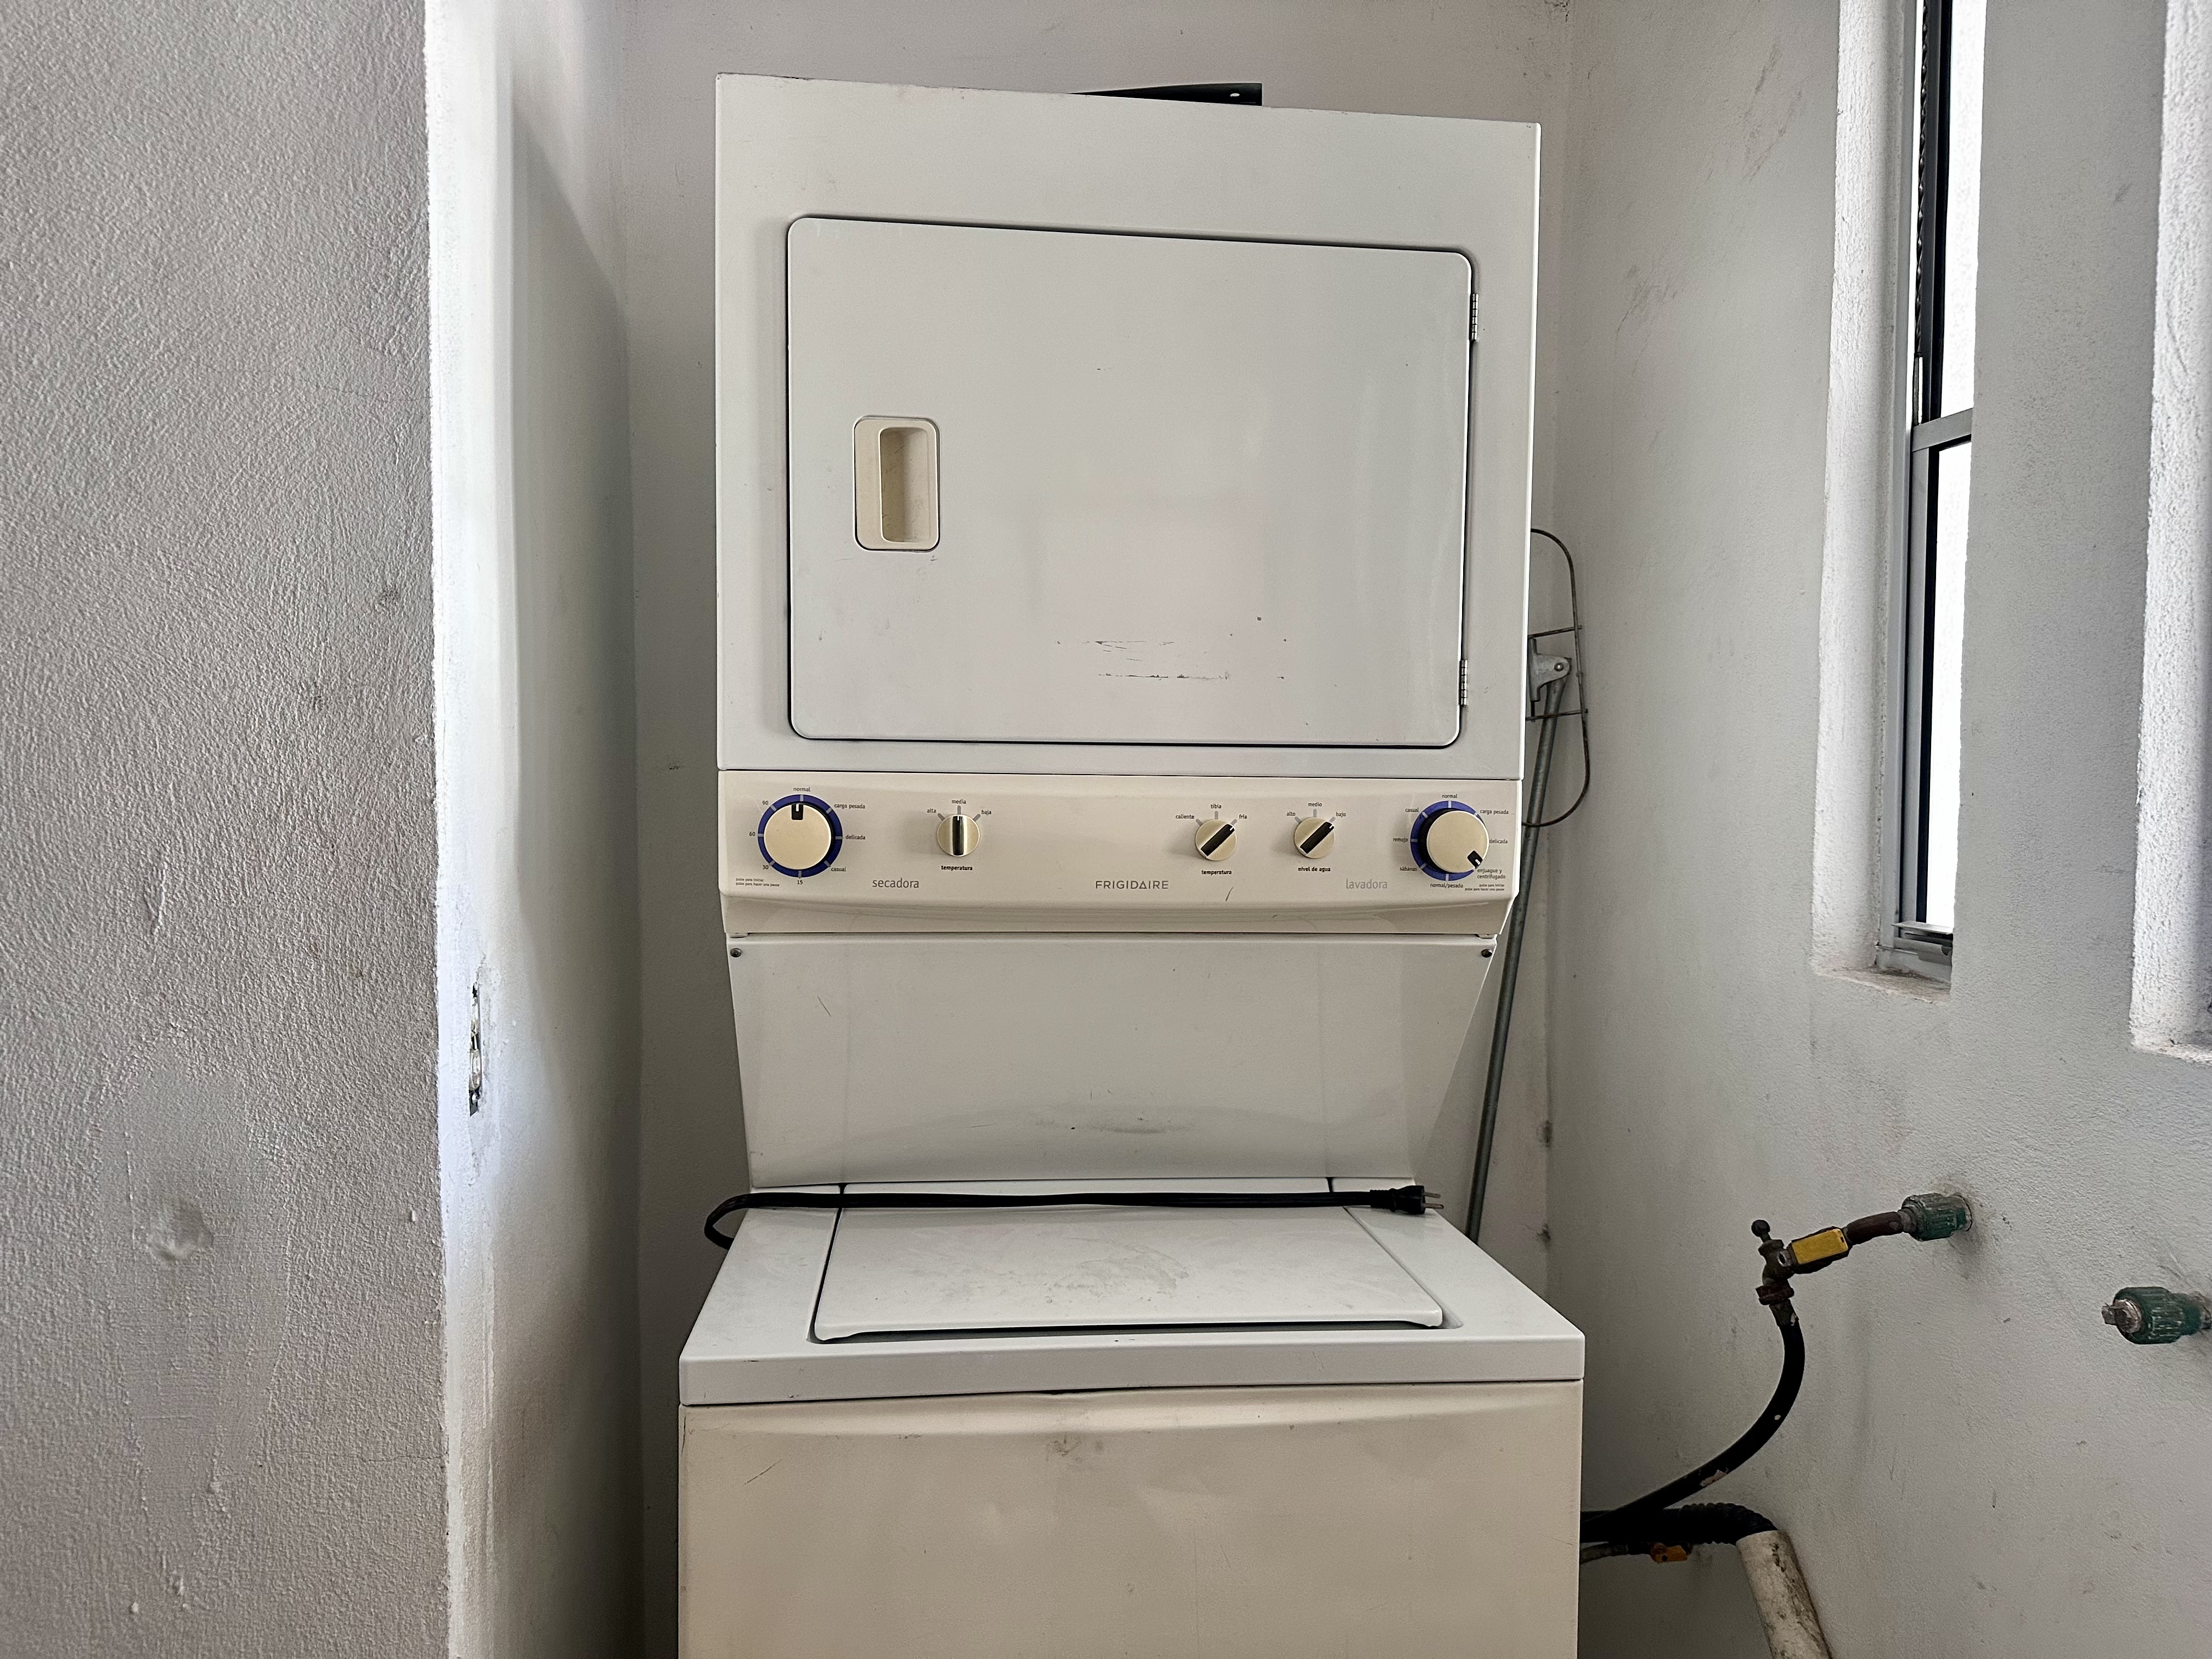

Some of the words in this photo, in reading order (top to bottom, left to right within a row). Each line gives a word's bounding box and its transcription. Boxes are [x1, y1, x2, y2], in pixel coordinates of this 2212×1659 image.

[872, 878, 919, 888] secadora
[1096, 881, 1169, 889] FRIGIDAIRE
[1346, 878, 1387, 889] lavadora
